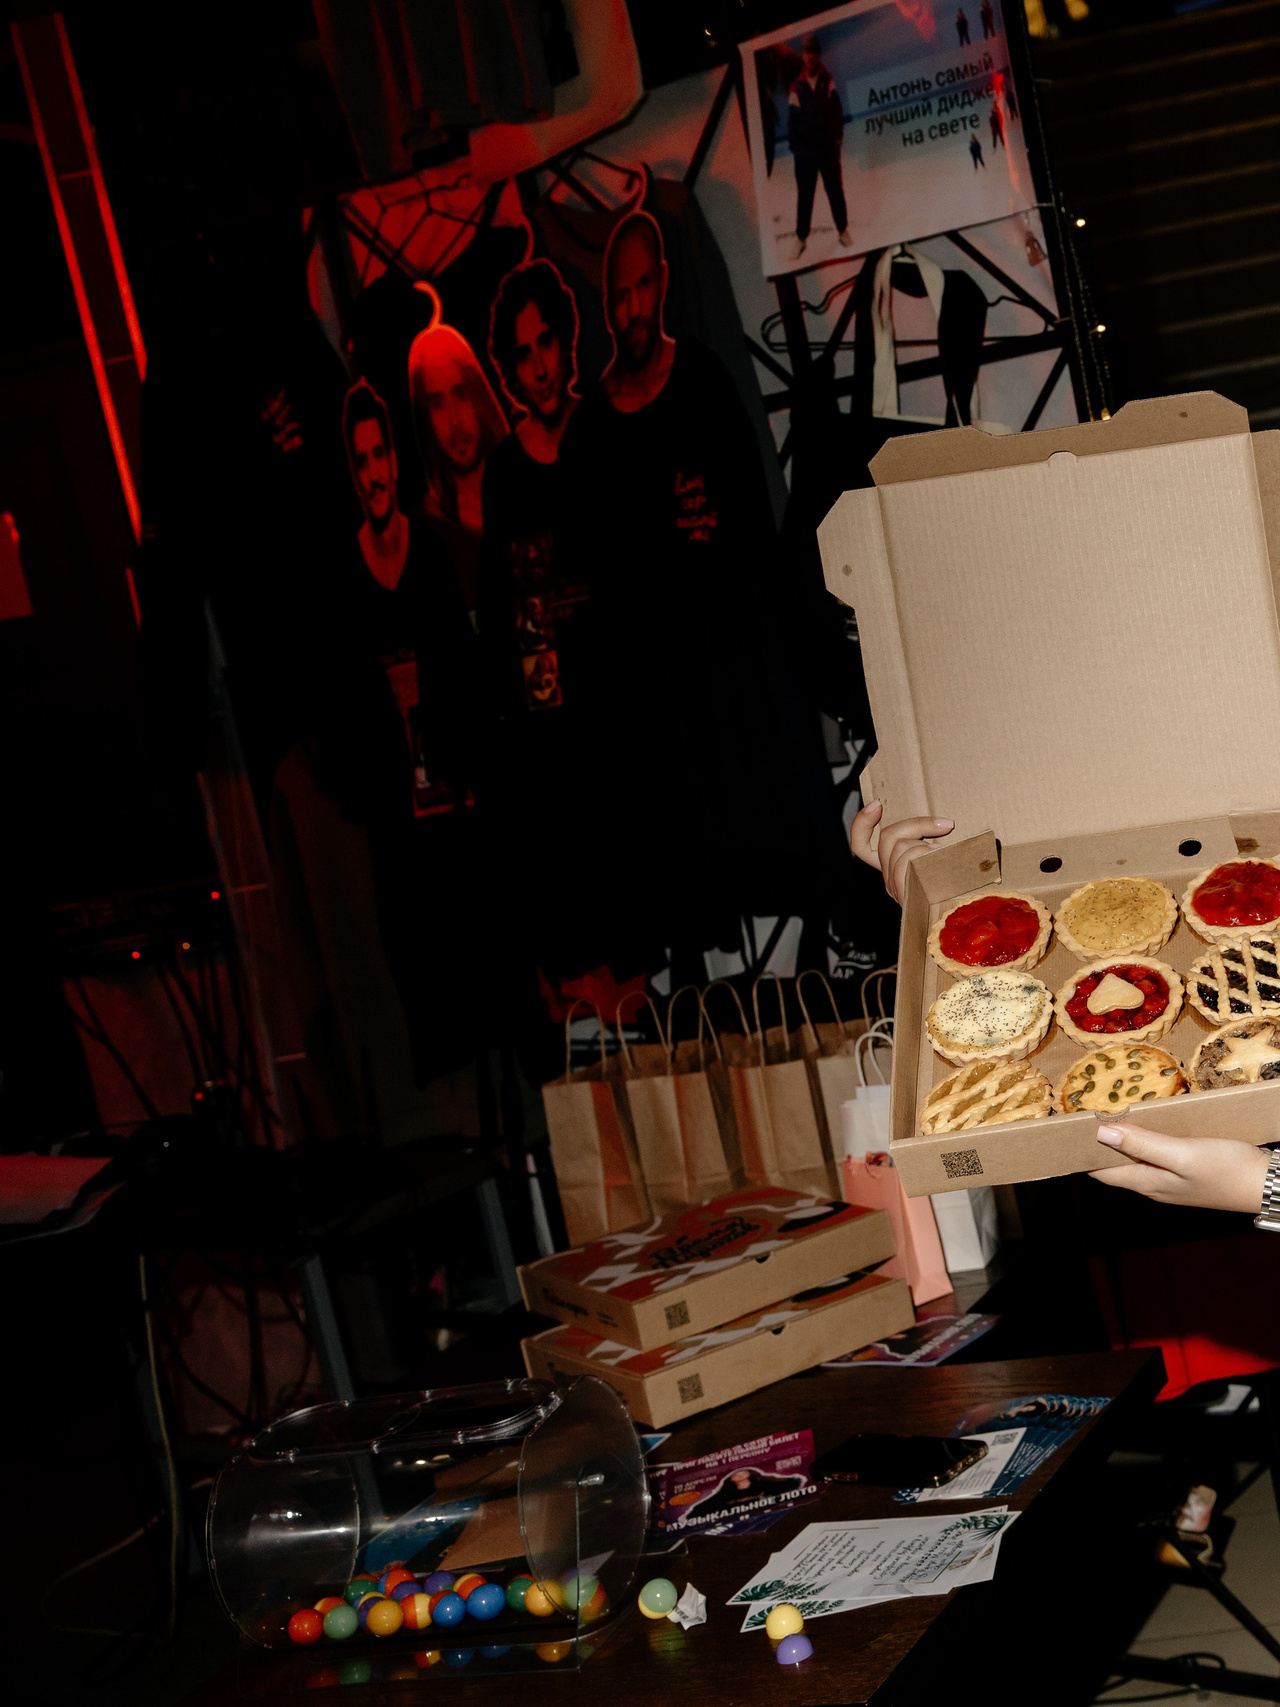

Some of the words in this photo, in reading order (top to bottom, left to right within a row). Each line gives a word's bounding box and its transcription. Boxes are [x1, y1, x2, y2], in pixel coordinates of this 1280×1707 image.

[867, 77, 932, 108] Антонь
[936, 52, 994, 88] самый
[865, 94, 932, 135] лучший
[938, 78, 1001, 115] дидже
[902, 126, 924, 147] на
[928, 112, 980, 141] свете
[666, 1496, 777, 1532] МУЗЫКАЛЬНОЕ
[778, 1485, 817, 1502] ЛОТО
